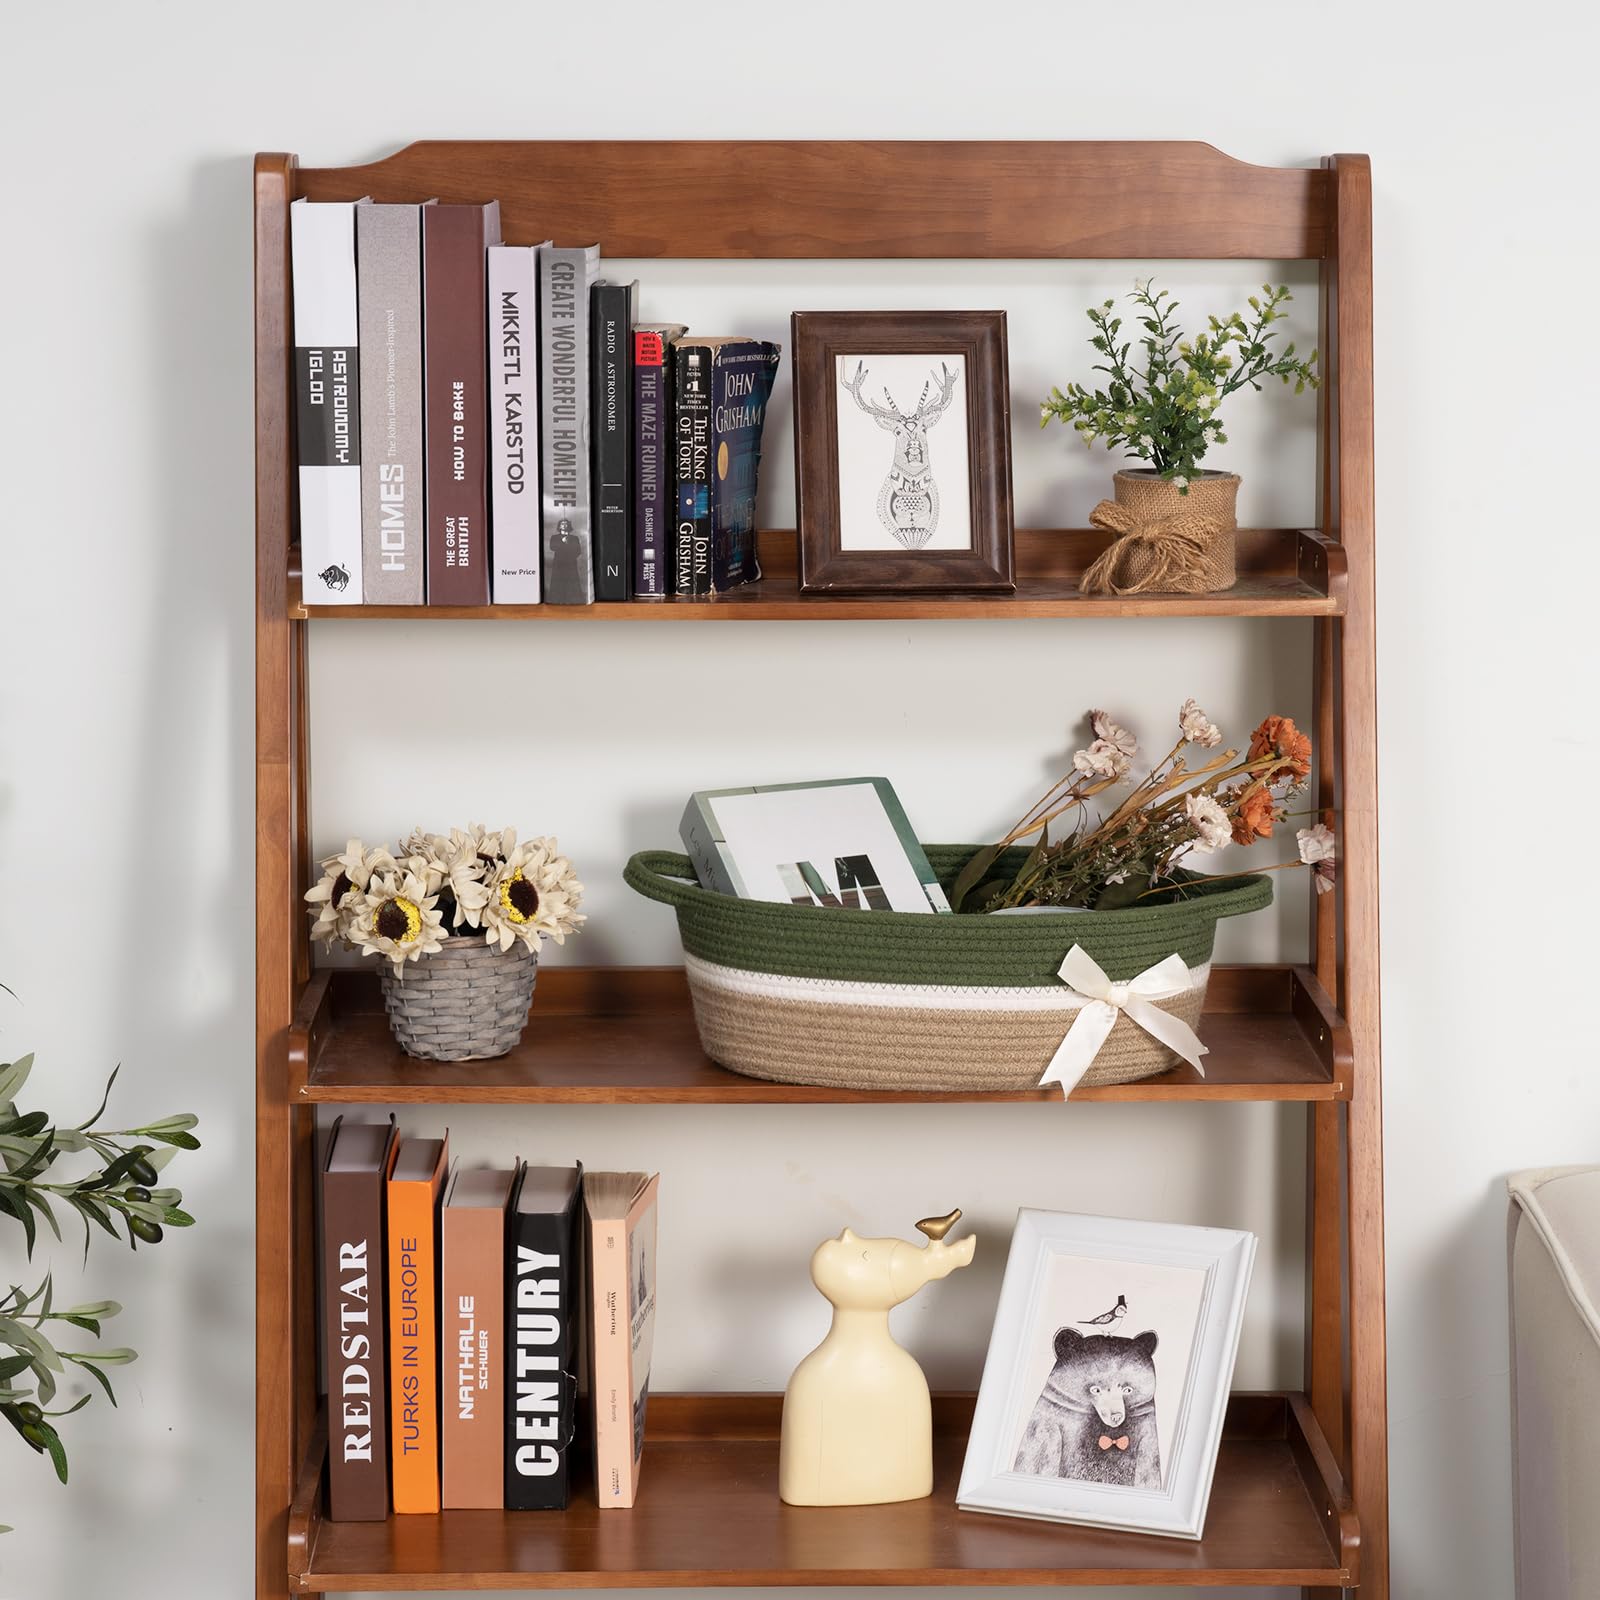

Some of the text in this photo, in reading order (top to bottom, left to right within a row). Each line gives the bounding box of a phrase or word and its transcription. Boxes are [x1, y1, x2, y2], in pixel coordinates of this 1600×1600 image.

[309, 350, 324, 405] IGLOO
[332, 350, 350, 464] ASTRONOMY
[387, 384, 397, 416] Lamb's
[501, 292, 525, 495] MIKKETL KARSTOD
[551, 262, 577, 508] CREATE WONDERFUL HOMELIFE
[606, 320, 616, 432] RADIO ASTRONOMER
[723, 371, 755, 404] JOHN
[386, 418, 397, 439] John
[387, 442, 397, 457] The
[452, 381, 465, 480] HOW TO BAKE
[641, 373, 657, 501] THE MAZE RUNNER
[679, 417, 693, 479] OF TORTS
[694, 417, 707, 480] THE KING
[716, 405, 762, 433] GRISHAM
[381, 464, 406, 571] HOMES
[446, 517, 456, 566] THE GREAT
[457, 517, 469, 567] BRITISH
[645, 508, 653, 542] DASHNER
[501, 567, 536, 576] New Price
[607, 565, 619, 576] N
[679, 522, 693, 588] GRISHAM
[692, 536, 708, 574] JOHN
[339, 1239, 373, 1464] REDSTAR
[401, 1237, 420, 1455] TURKS IN EUROPE
[458, 1295, 474, 1420] NATHALIE
[478, 1330, 489, 1390] SCHWER
[515, 1245, 560, 1477] CENTURY
